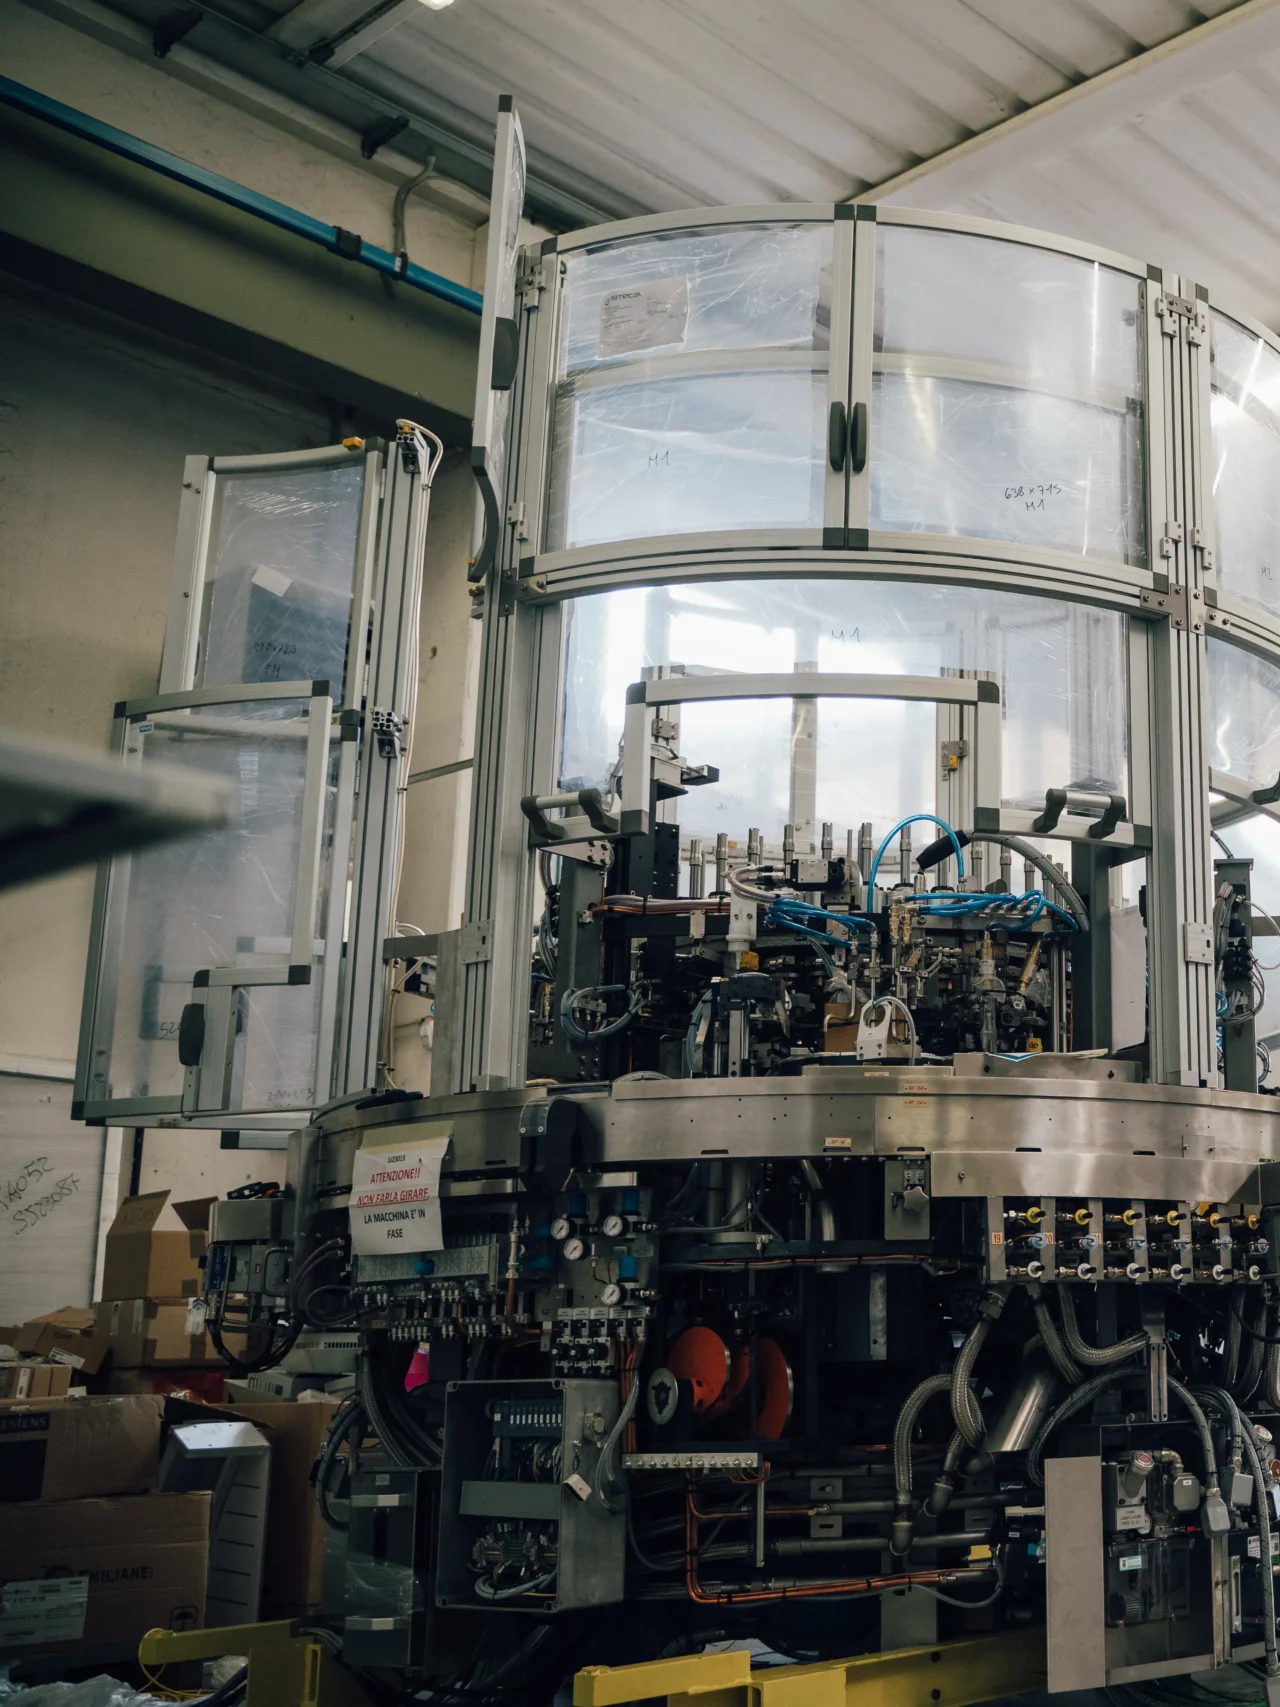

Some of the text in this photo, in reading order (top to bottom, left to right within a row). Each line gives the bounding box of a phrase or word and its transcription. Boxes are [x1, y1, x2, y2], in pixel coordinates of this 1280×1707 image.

[370, 1167, 421, 1184] ATTENZIONE!!
[356, 1187, 430, 1206] NON FARLA GIRARE
[364, 1208, 426, 1224] LA MACCHINA E' IN
[387, 1228, 403, 1239] FASE
[993, 1233, 1001, 1244] 19
[0, 1415, 48, 1430] EMENS
